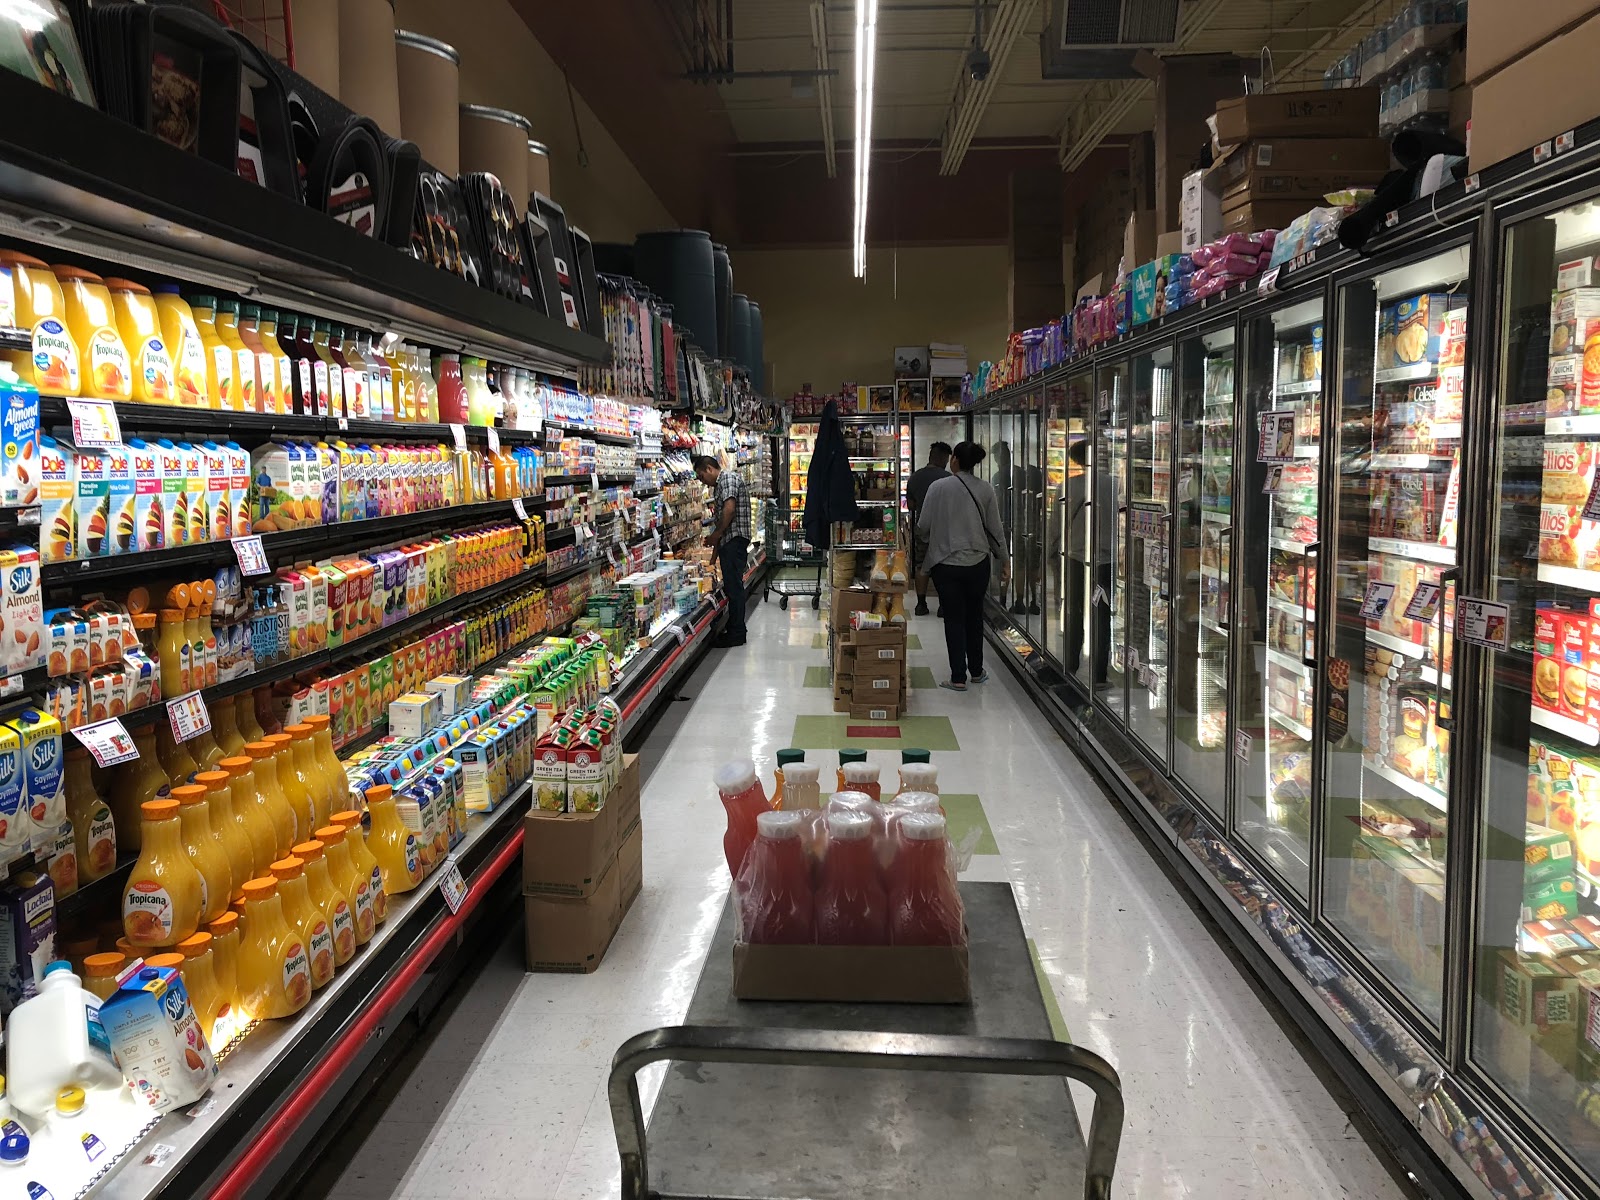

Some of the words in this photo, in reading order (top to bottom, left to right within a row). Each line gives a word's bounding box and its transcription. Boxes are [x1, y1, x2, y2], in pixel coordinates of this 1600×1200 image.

[37, 334, 69, 351] Tropicana
[95, 343, 123, 359] Tropicana
[146, 352, 168, 368] Tropicana
[1553, 364, 1573, 374] QUICHE
[4, 400, 38, 427] Almond
[13, 418, 36, 438] Breeze
[41, 455, 66, 471] Dole
[81, 455, 103, 471] Dole
[135, 456, 154, 470] Dole
[164, 456, 180, 470] Dole
[209, 457, 224, 469] Dole
[232, 457, 245, 468] Dole
[1401, 475, 1423, 491] Celeste
[10, 567, 31, 593] Silk
[7, 590, 39, 608] Almond
[29, 728, 56, 741] PROTEIN
[32, 740, 56, 771] Silk
[0, 754, 16, 780] ilk
[34, 768, 59, 786] Soymilk
[0, 784, 19, 799] oymilk
[41, 781, 56, 790] VANILLA
[1, 797, 17, 807] VANILLA
[91, 821, 113, 838] Tropicana
[26, 888, 53, 913] Lactaid
[129, 894, 166, 905] Tropicana
[311, 933, 330, 950] Tropicana
[285, 954, 305, 974] Tropicana
[166, 990, 185, 1021] Silk
[114, 1021, 130, 1030] SIMPLE
[131, 1013, 151, 1024] REASONS
[125, 1010, 133, 1018] 3
[173, 1009, 196, 1037] Almond
[153, 1056, 166, 1065] TRY
